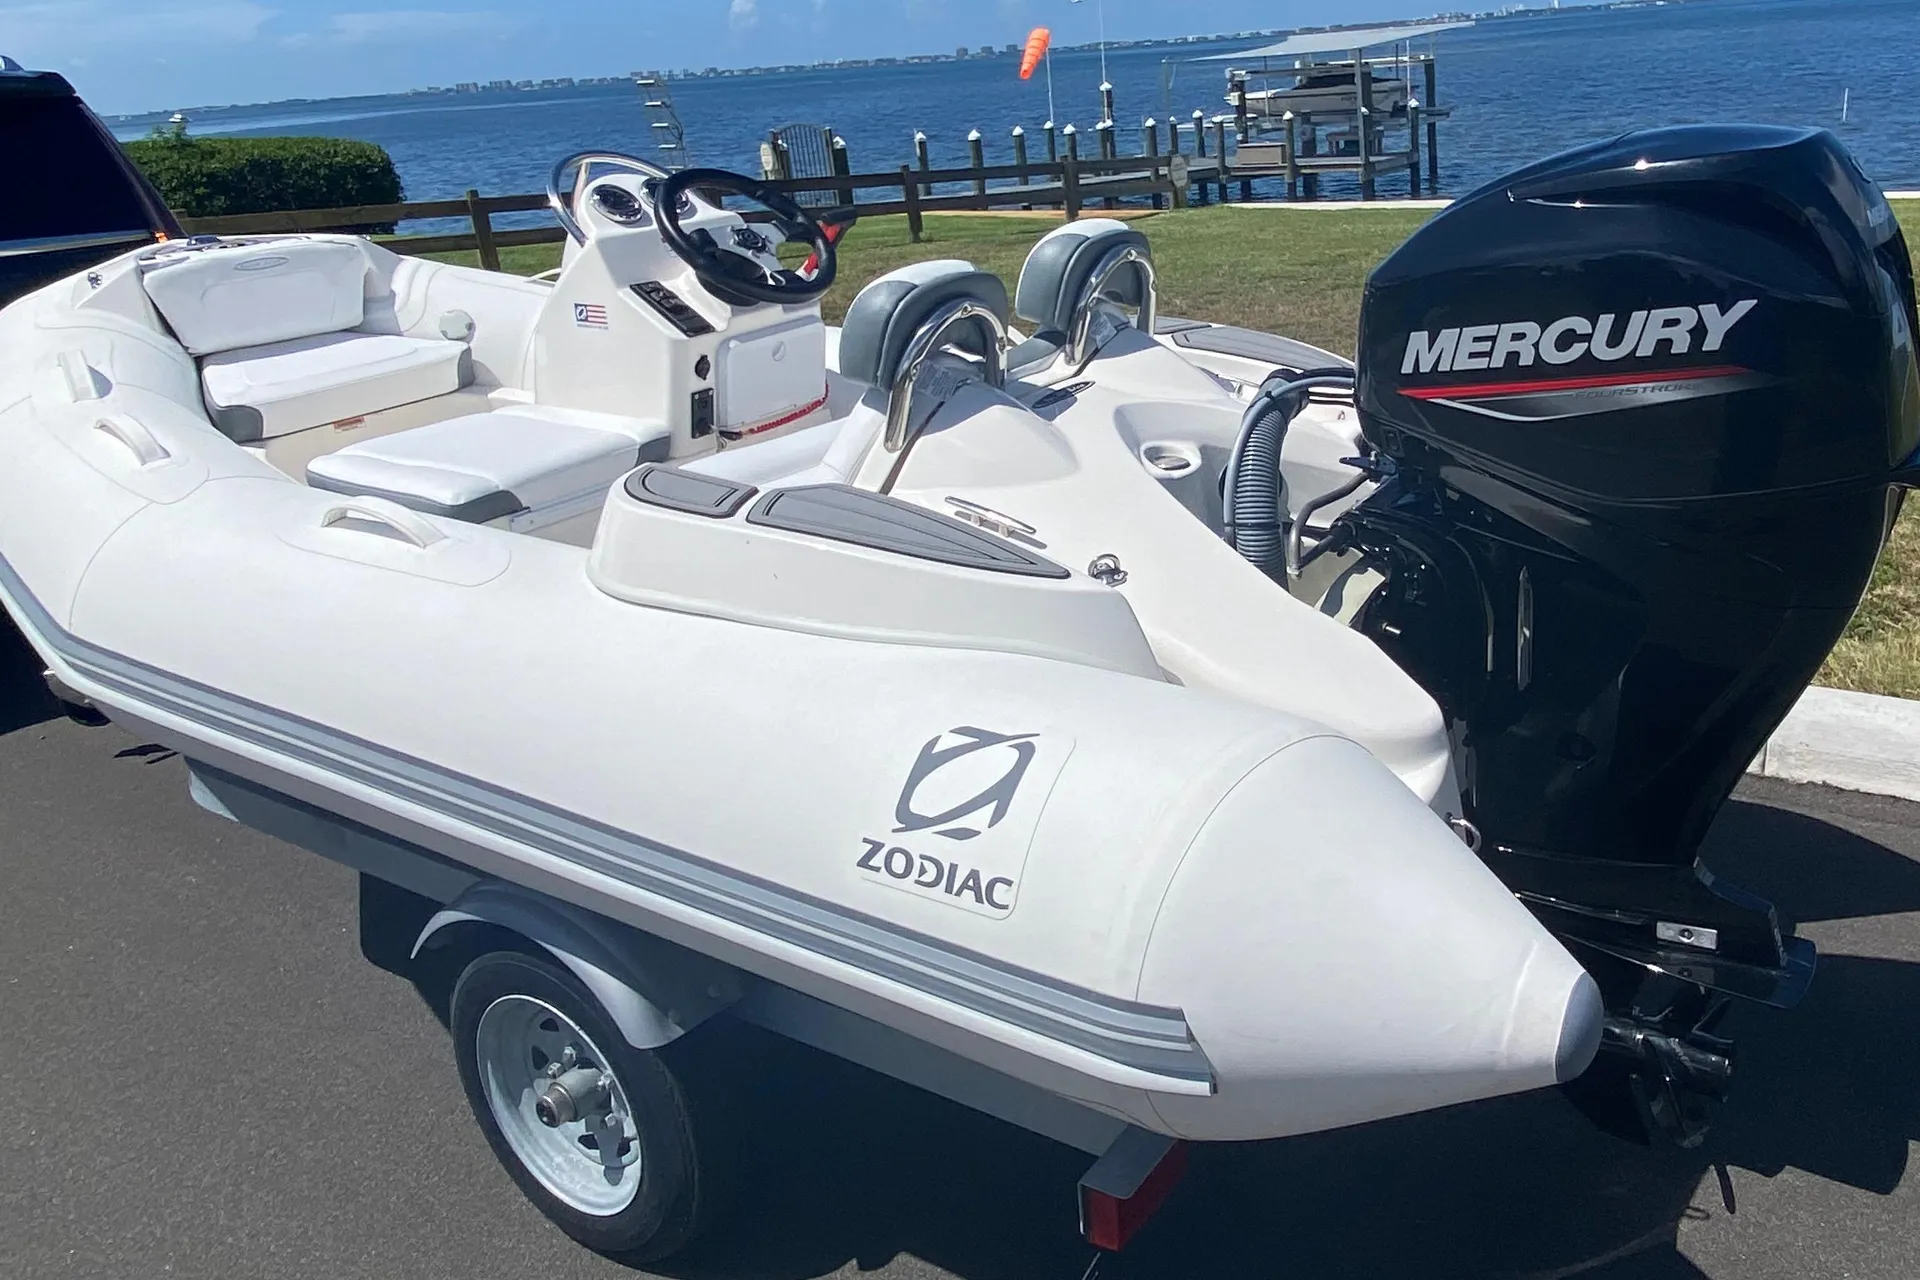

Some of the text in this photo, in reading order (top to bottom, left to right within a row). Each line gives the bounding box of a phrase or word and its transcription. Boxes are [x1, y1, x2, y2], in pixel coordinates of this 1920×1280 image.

[1400, 298, 1759, 375] MERCURY
[1574, 382, 1694, 400] FOURSTROK
[856, 837, 1014, 910] ZODIAC
